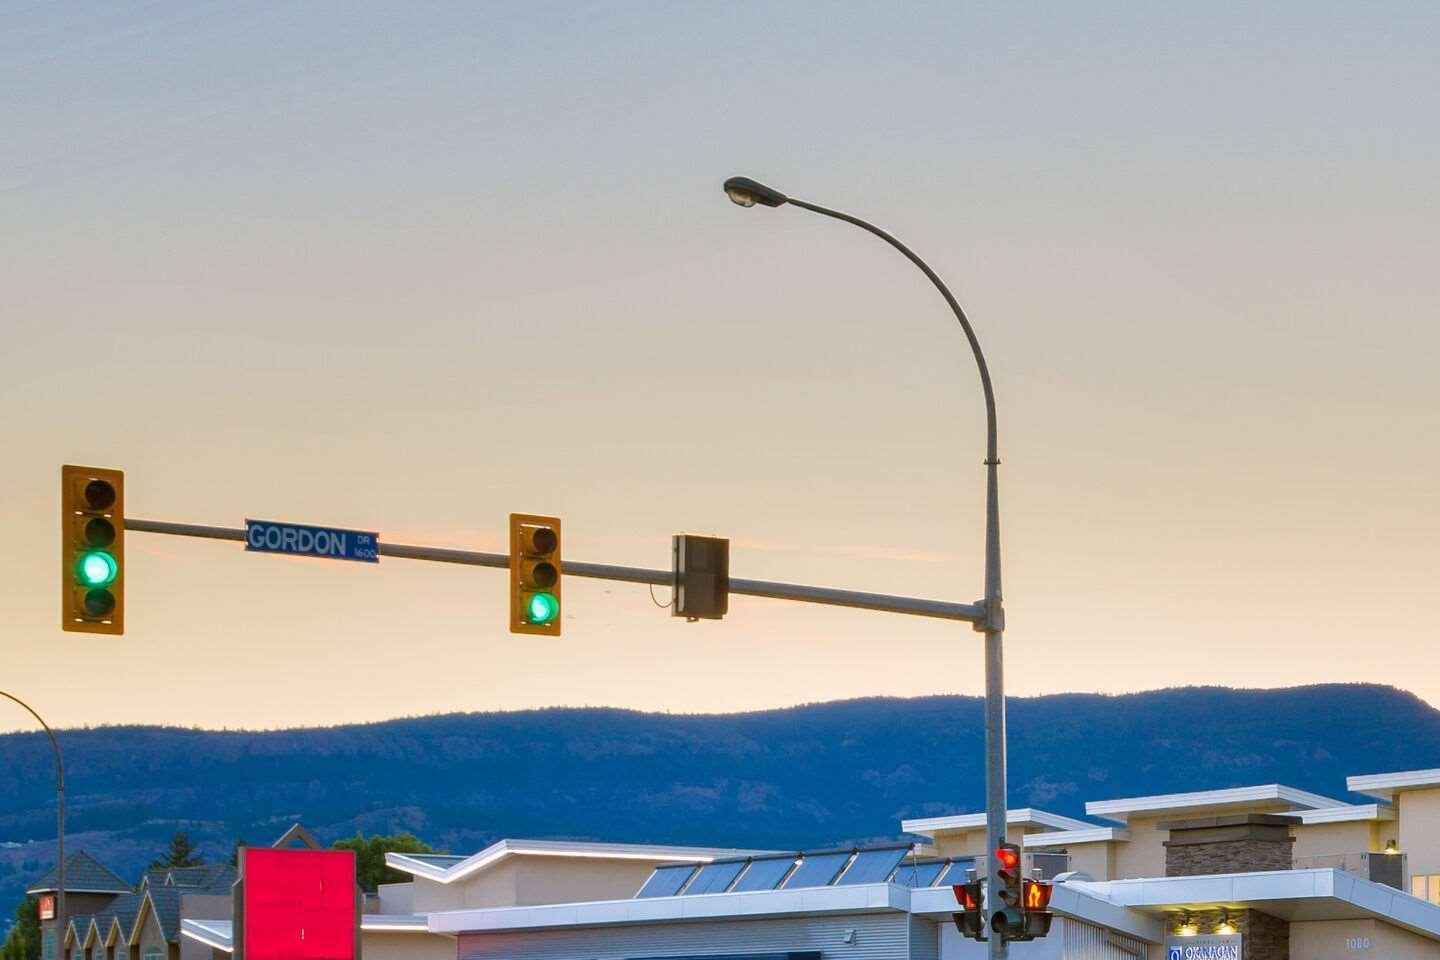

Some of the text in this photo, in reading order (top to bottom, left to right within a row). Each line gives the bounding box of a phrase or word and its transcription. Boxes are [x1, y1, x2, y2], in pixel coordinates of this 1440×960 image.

[249, 524, 370, 556] GORDON DR
[1346, 937, 1370, 949] 1080
[1185, 945, 1238, 959] OKANAGAN
